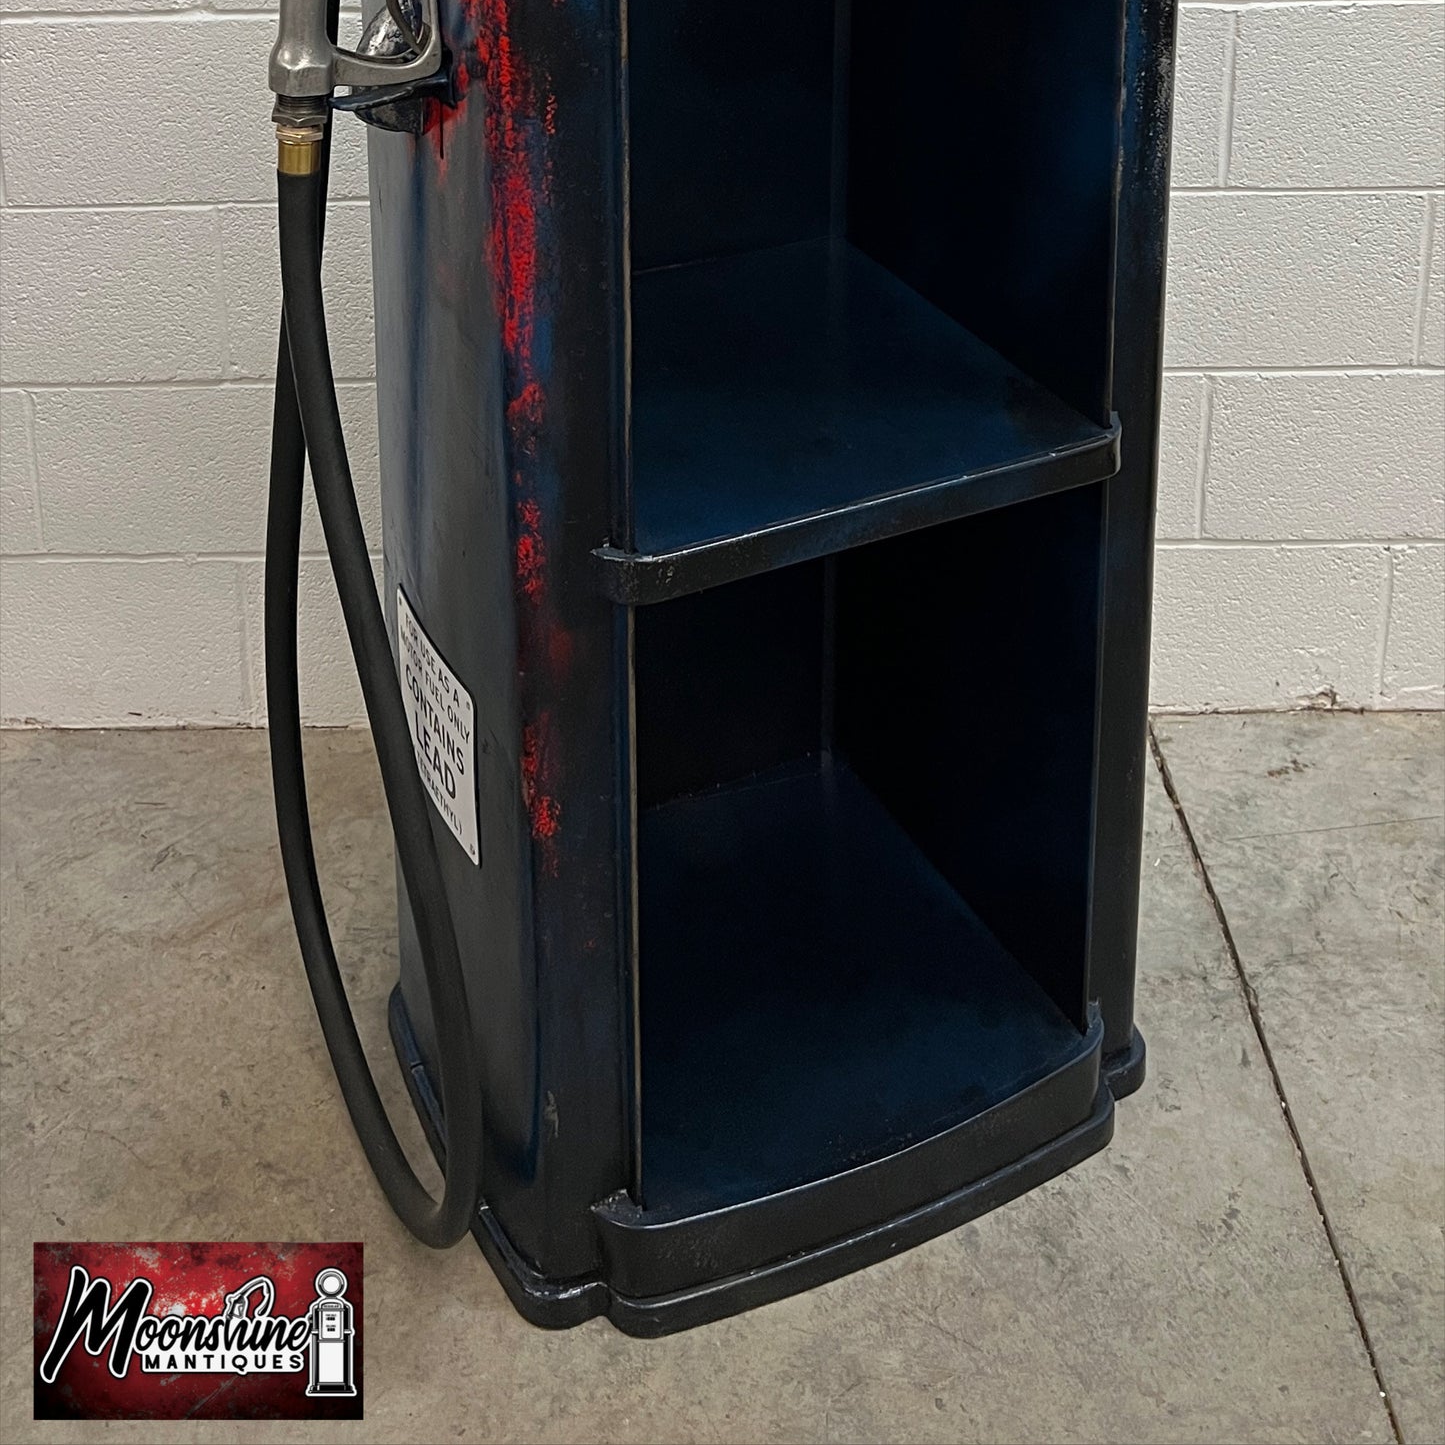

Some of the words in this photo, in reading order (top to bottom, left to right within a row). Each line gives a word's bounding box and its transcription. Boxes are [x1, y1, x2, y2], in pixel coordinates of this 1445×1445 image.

[400, 624, 423, 676] MOTOR
[425, 669, 446, 712] FUEL
[447, 704, 470, 744] ONLY
[405, 612, 419, 647] FOR
[420, 639, 436, 675] USE
[438, 667, 450, 694] AS
[453, 688, 460, 708] A
[405, 664, 465, 776] CONTAINS
[414, 709, 456, 800] LEAD
